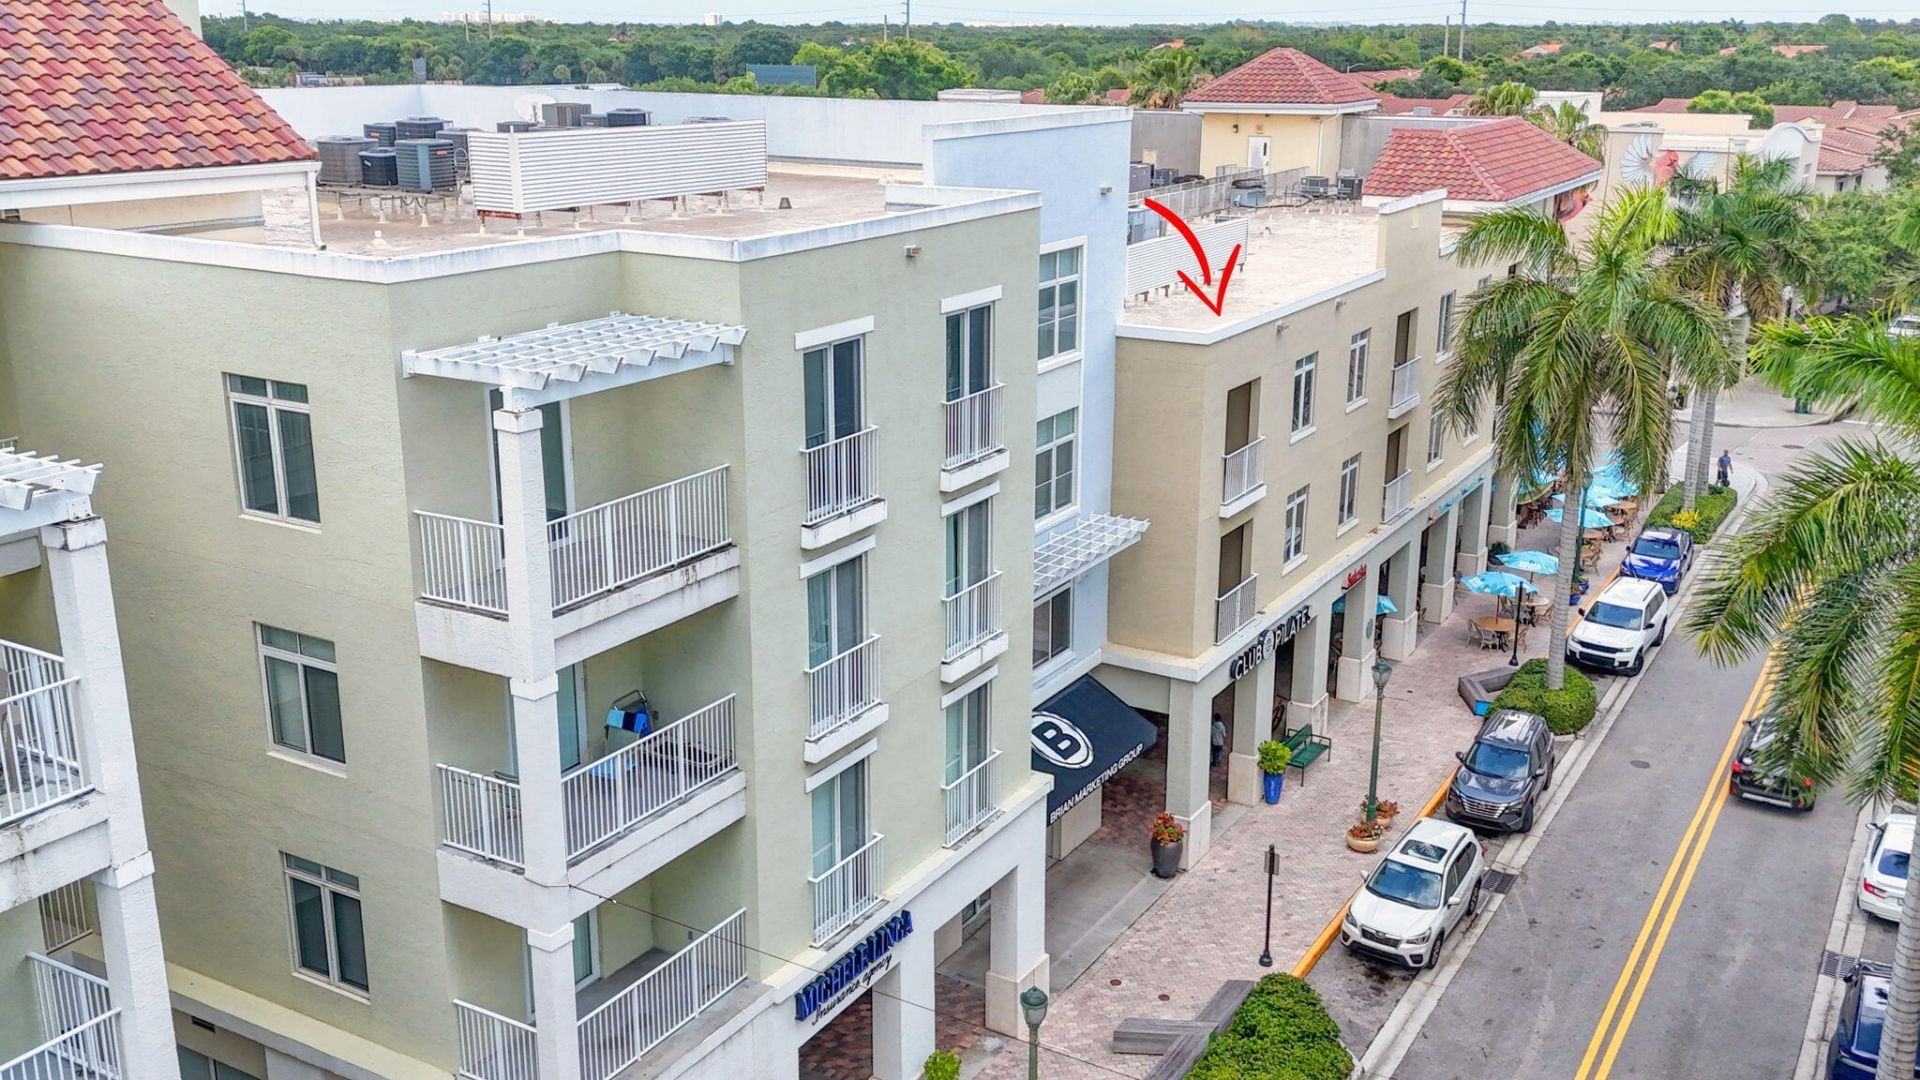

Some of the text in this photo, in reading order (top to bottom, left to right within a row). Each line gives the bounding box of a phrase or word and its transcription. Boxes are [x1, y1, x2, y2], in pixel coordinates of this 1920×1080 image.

[1230, 605, 1312, 680] CLUB PILATES
[1032, 721, 1081, 761] B
[1050, 743, 1144, 825] BRIAN MARKETING GROUP
